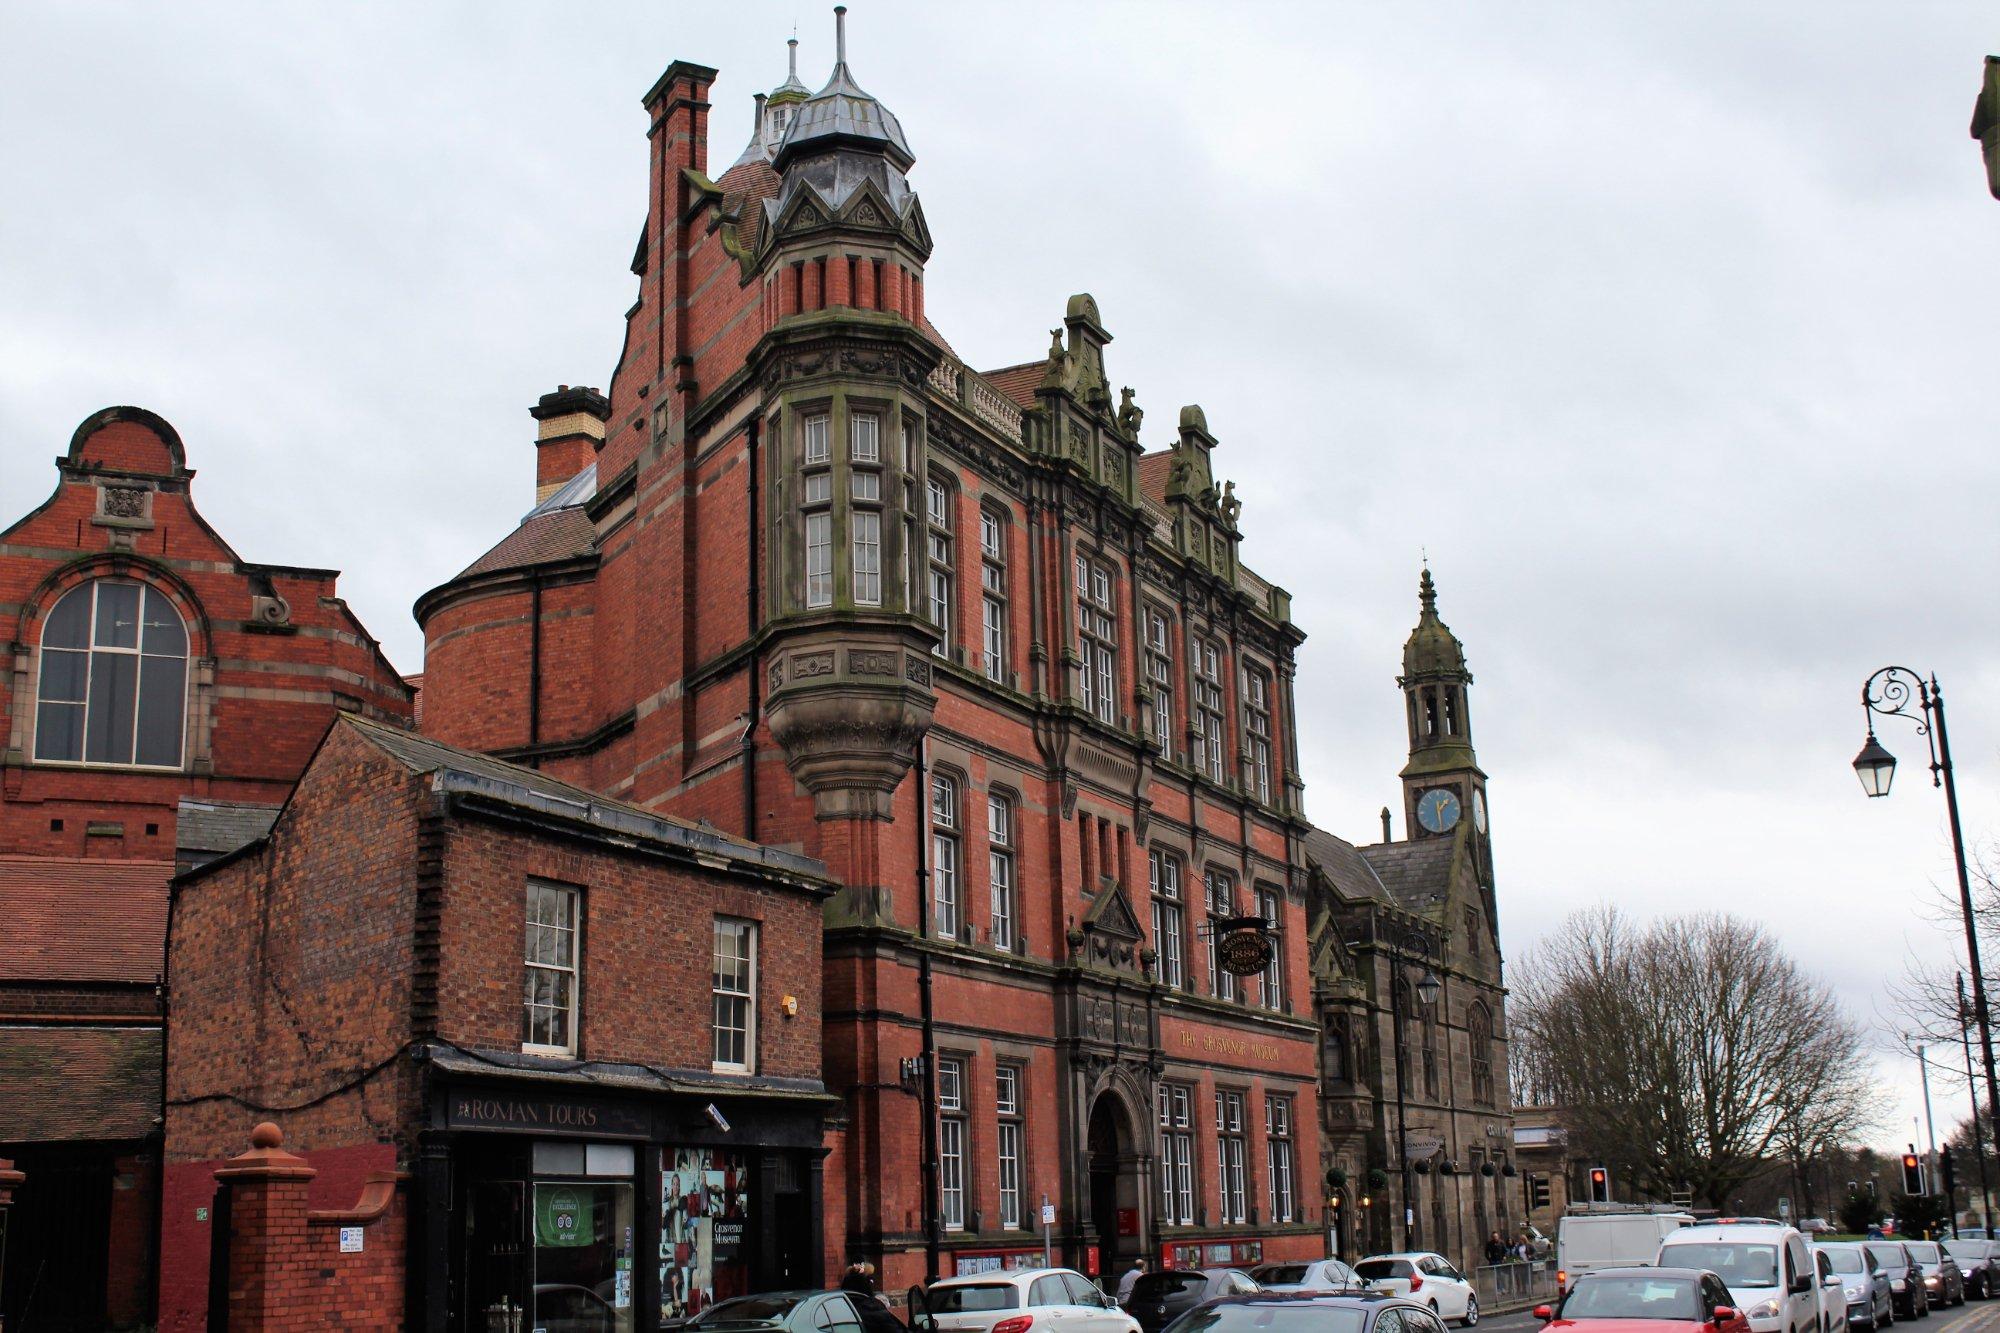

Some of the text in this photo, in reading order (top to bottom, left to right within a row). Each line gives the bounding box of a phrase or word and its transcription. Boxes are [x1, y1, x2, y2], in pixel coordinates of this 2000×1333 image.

[1222, 936, 1269, 953] GROSVENOR
[1226, 957, 1267, 972] MUSEUM
[1181, 1030, 1280, 1060] THE GROSVENOR MUSEUM
[472, 1100, 539, 1122] ROMAN
[548, 1104, 597, 1126] TOURS
[1404, 1141, 1437, 1149] ONVIVIO
[714, 1222, 743, 1233] Grosvenor
[714, 1233, 741, 1244] Museum
